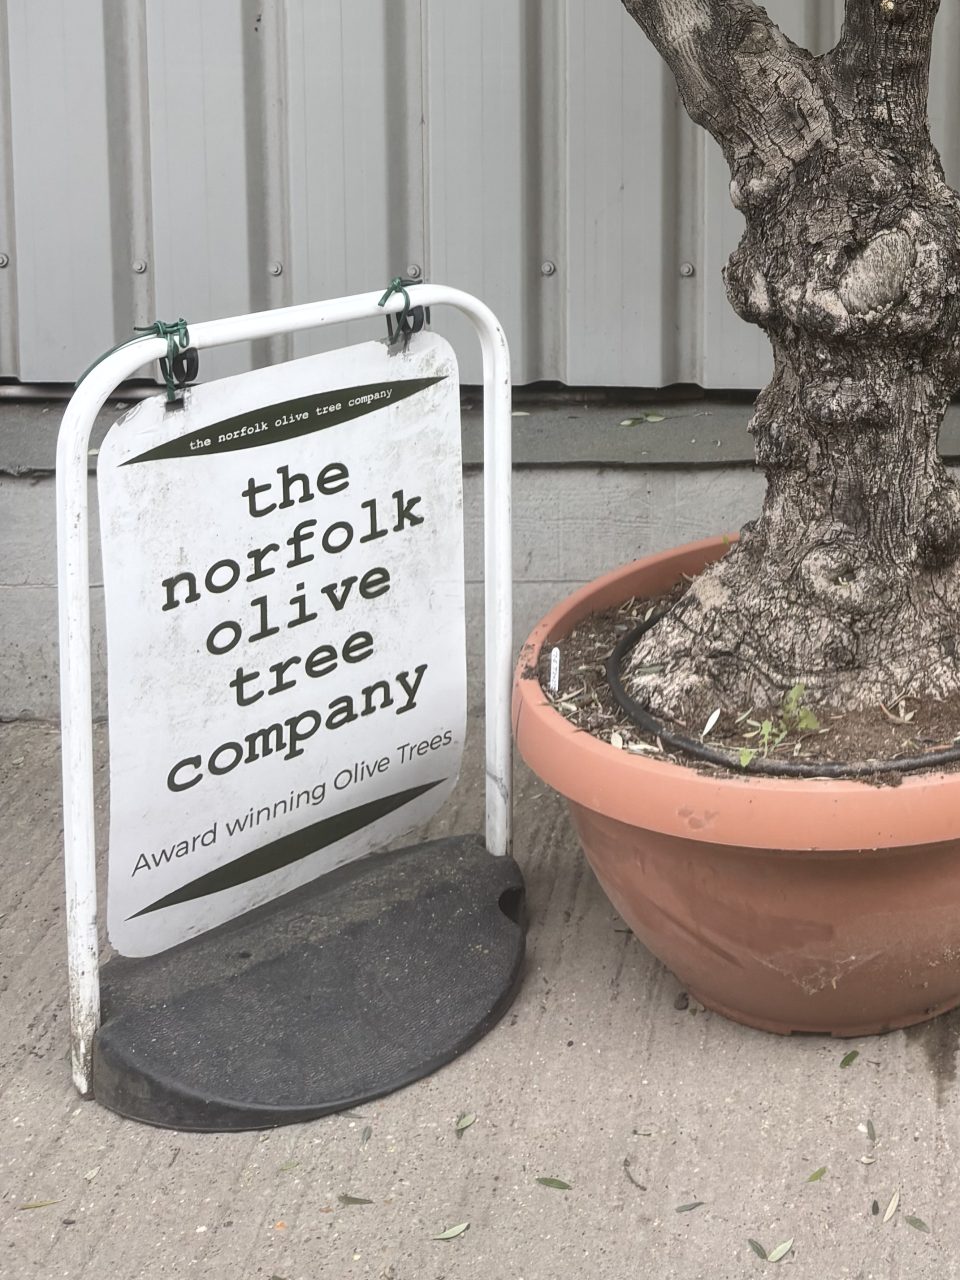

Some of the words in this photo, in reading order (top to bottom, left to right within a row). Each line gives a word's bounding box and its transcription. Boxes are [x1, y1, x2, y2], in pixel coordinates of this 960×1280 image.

[189, 436, 212, 450] the
[217, 421, 268, 443] norfolk
[274, 411, 309, 427] olive
[315, 402, 342, 417] tree
[348, 388, 393, 407] company
[241, 461, 350, 518] the
[161, 489, 425, 612] norfolk
[206, 566, 391, 656] olive
[229, 630, 374, 707] tree
[166, 663, 428, 793] company
[131, 822, 217, 878] Award
[225, 783, 326, 837] winning
[333, 755, 391, 791] Olive
[396, 729, 453, 765] Trees
